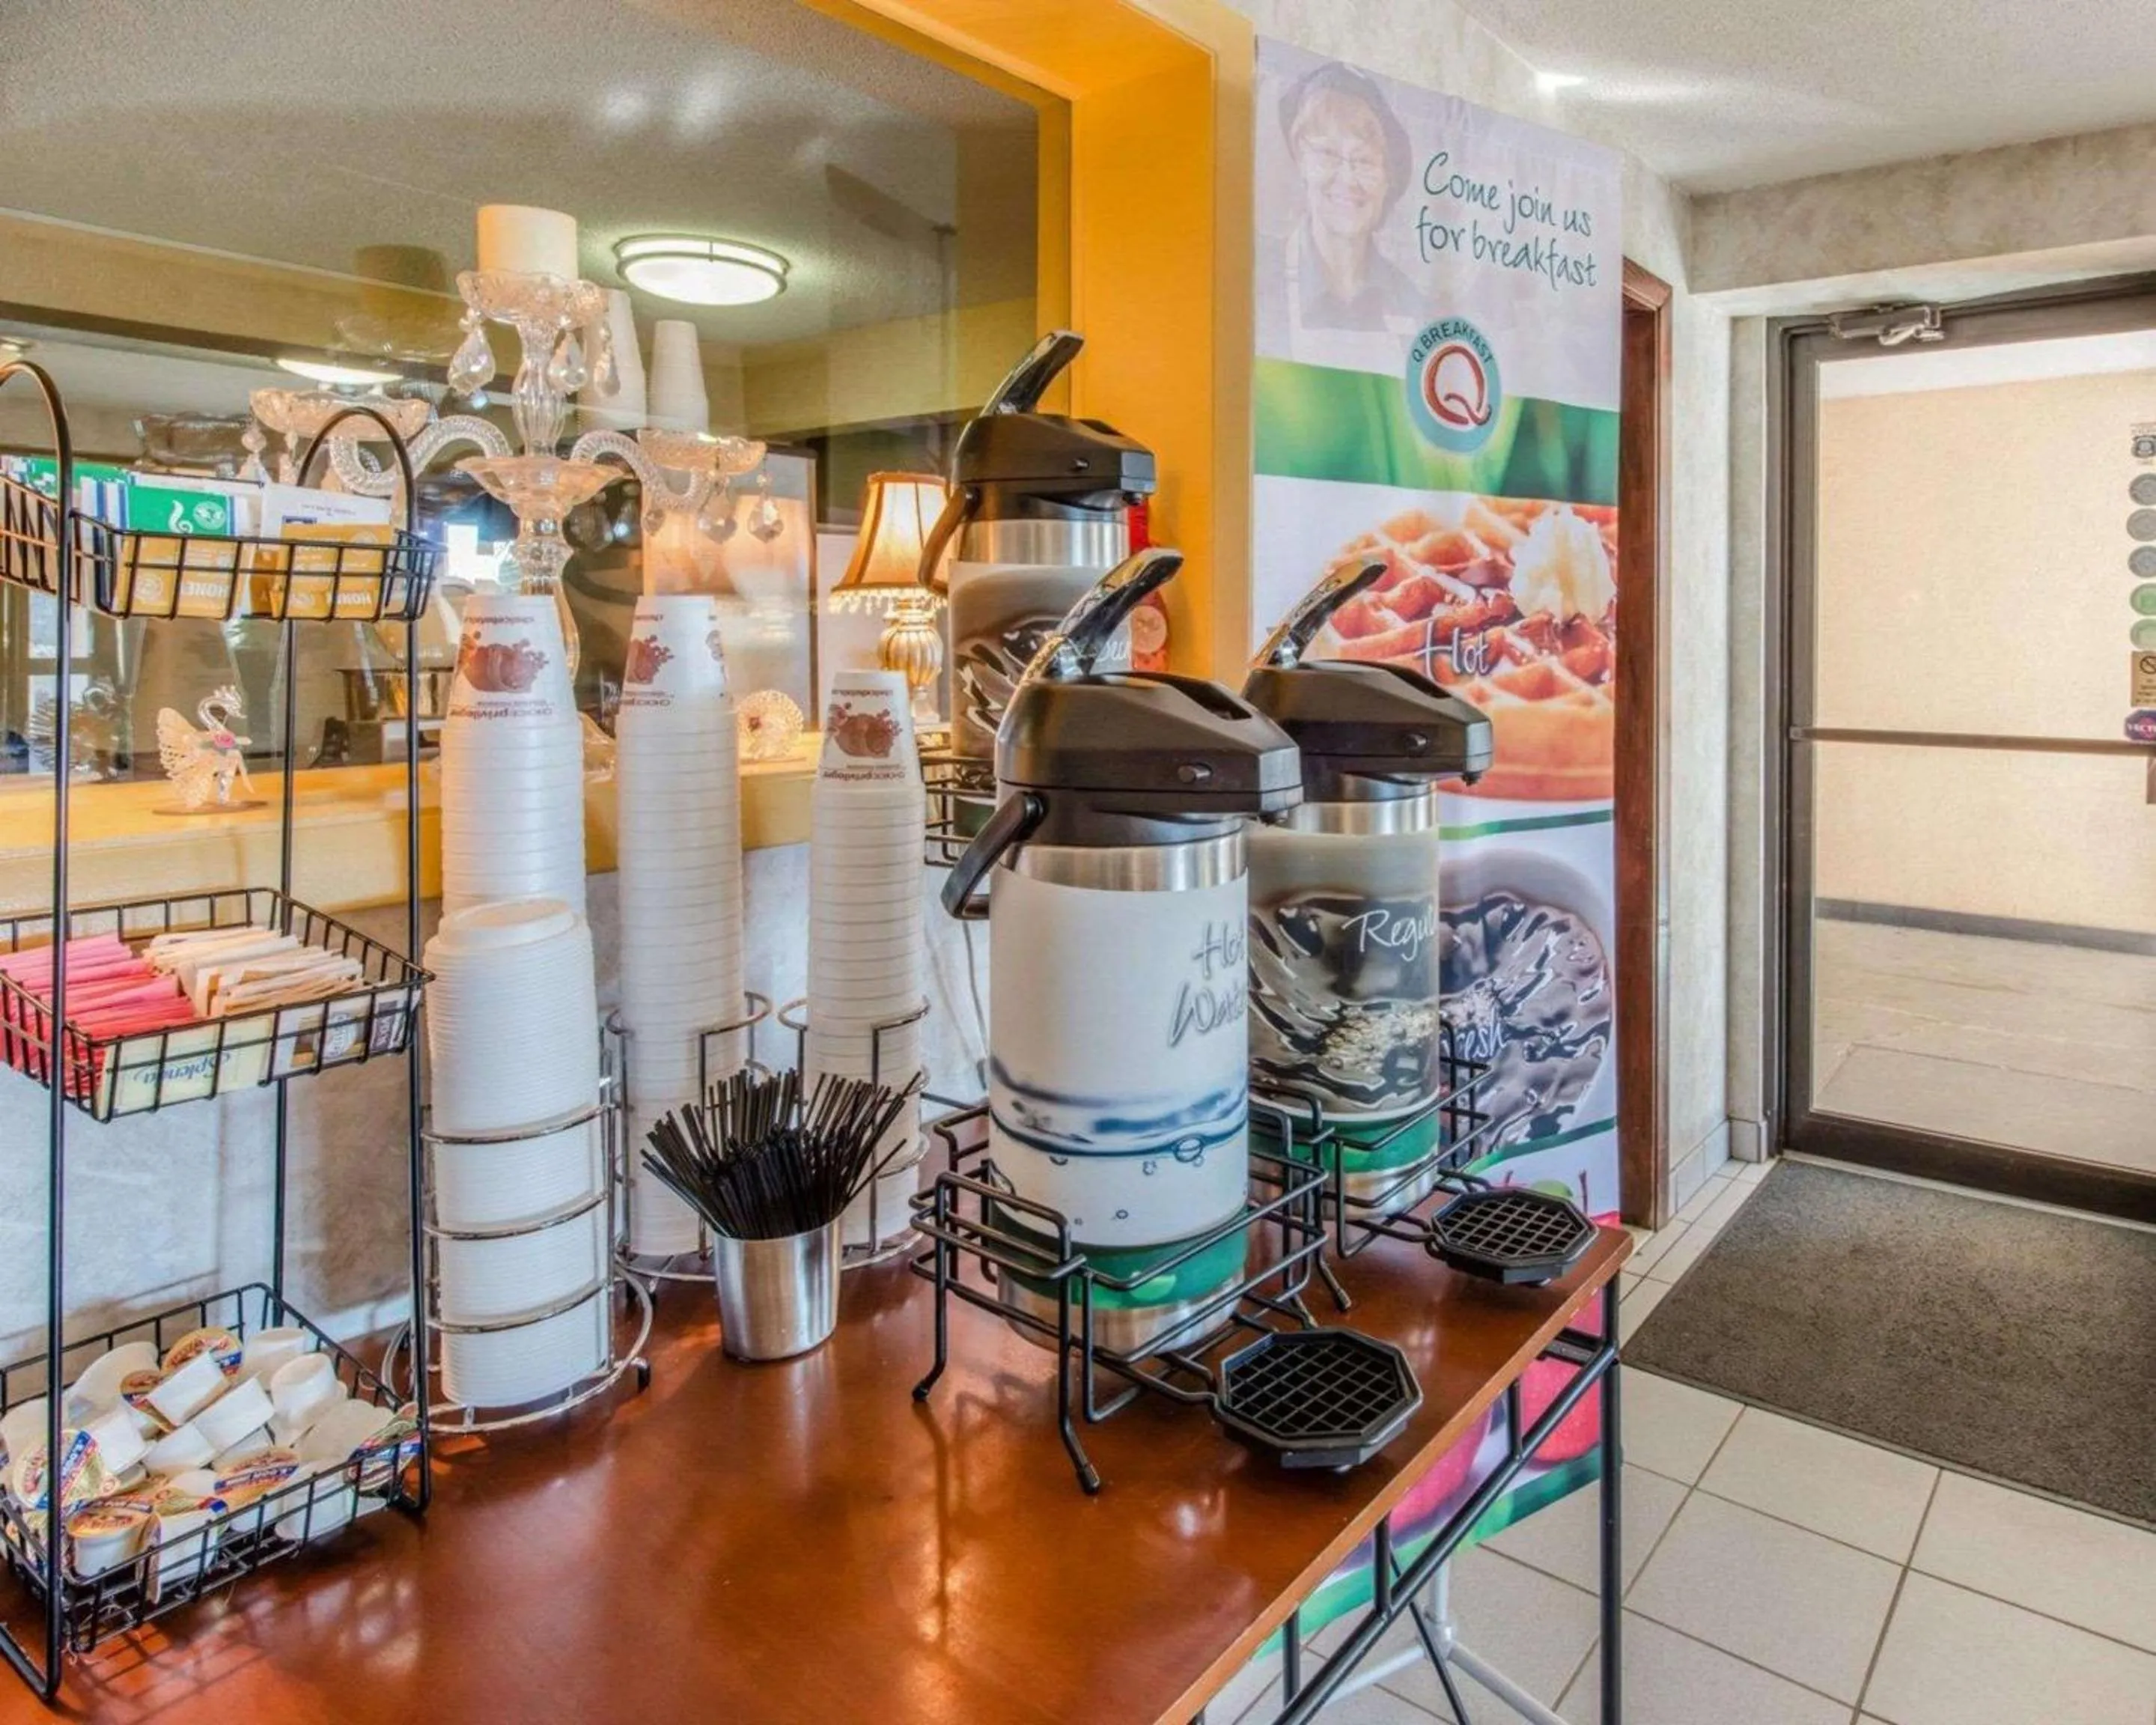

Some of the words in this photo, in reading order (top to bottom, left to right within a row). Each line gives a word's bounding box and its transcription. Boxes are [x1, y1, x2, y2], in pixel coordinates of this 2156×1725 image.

[1424, 151, 1500, 210] Come
[1503, 180, 1556, 235] join
[1564, 207, 1592, 237] us
[1416, 205, 1466, 264] for
[1473, 219, 1598, 292] breakfast
[1412, 348, 1425, 363] Q
[1421, 321, 1493, 363] BREAKFAST
[1424, 344, 1493, 426] Q
[1414, 617, 1488, 687] Hot
